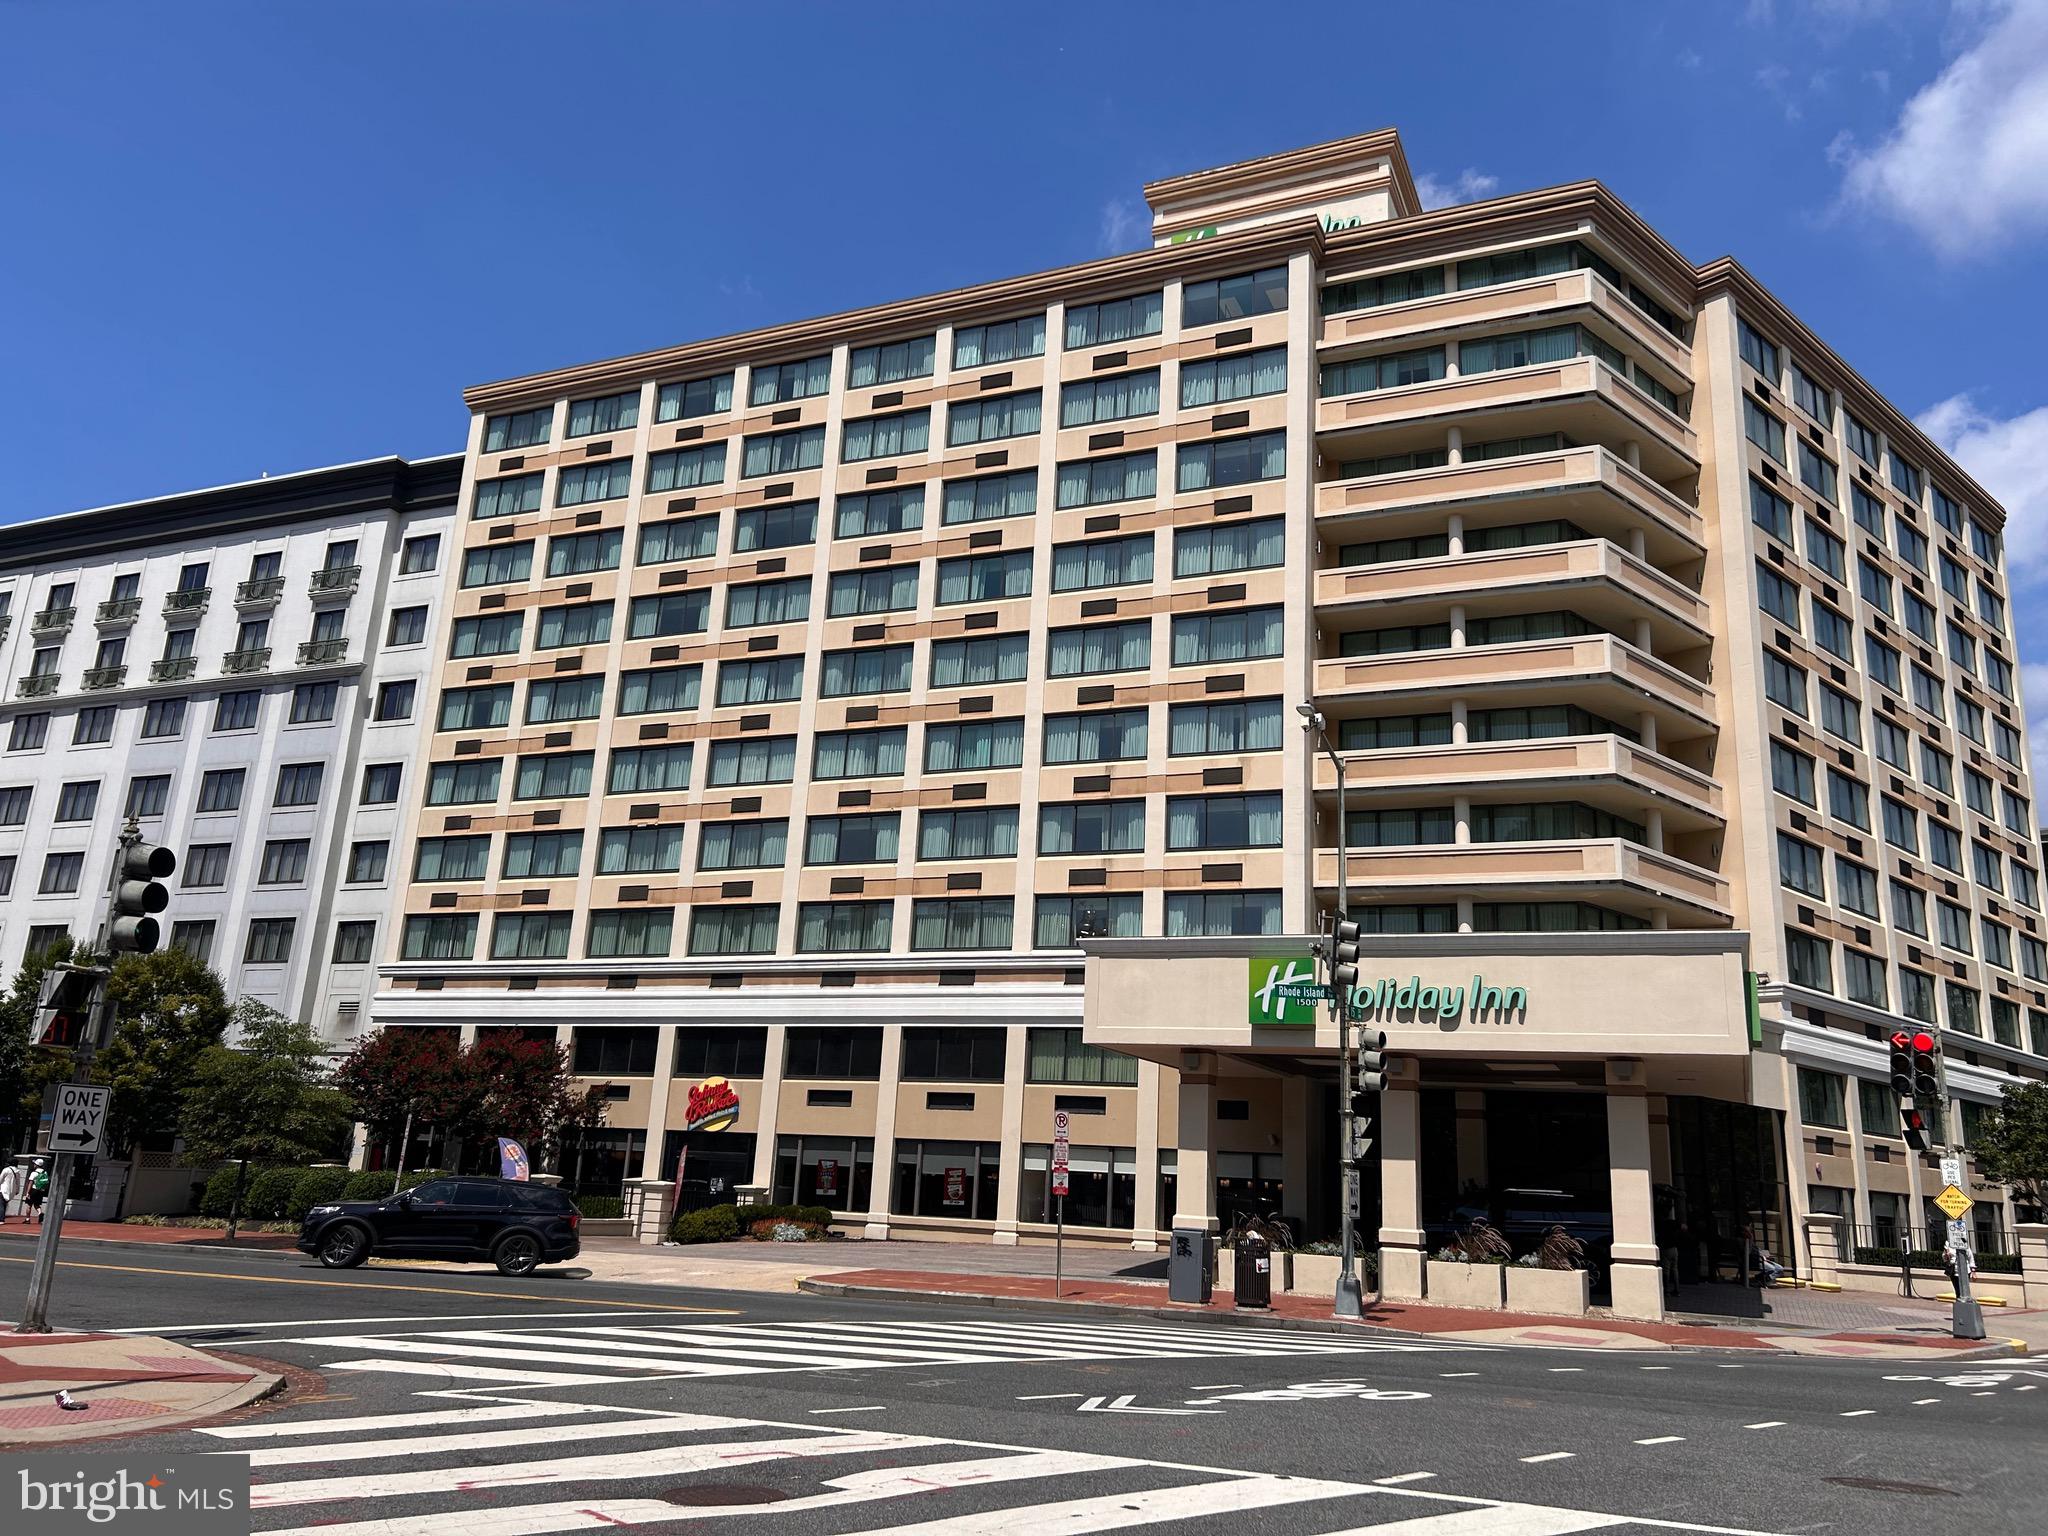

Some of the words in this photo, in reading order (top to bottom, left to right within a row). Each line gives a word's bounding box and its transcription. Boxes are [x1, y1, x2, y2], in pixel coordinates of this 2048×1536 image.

[1278, 985, 1301, 997] Rhode
[1303, 986, 1325, 998] Island
[1469, 974, 1527, 1010] Inn
[1296, 998, 1318, 1007] 1500
[64, 1090, 103, 1108] ONE
[62, 1109, 101, 1126] WAY
